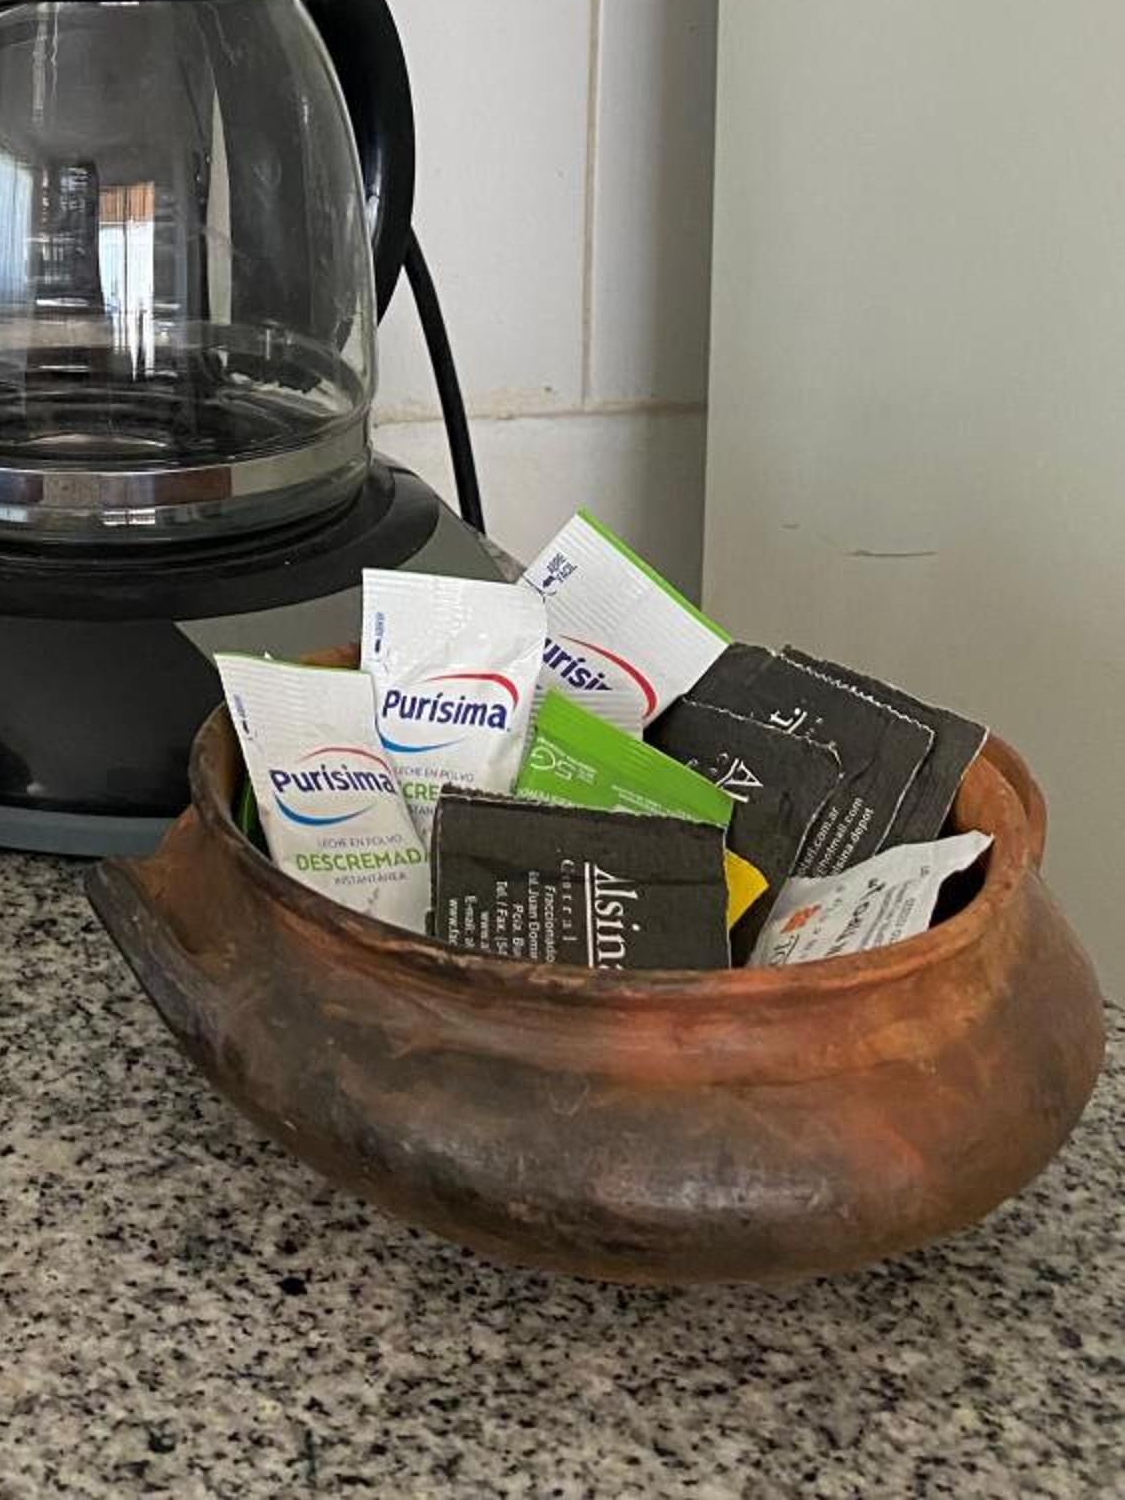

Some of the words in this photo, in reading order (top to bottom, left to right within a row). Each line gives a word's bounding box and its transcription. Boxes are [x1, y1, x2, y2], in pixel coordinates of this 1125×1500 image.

[543, 638, 613, 691] urísi
[382, 689, 509, 730] Purísima
[269, 764, 397, 795] Purísima
[527, 888, 540, 919] Juan
